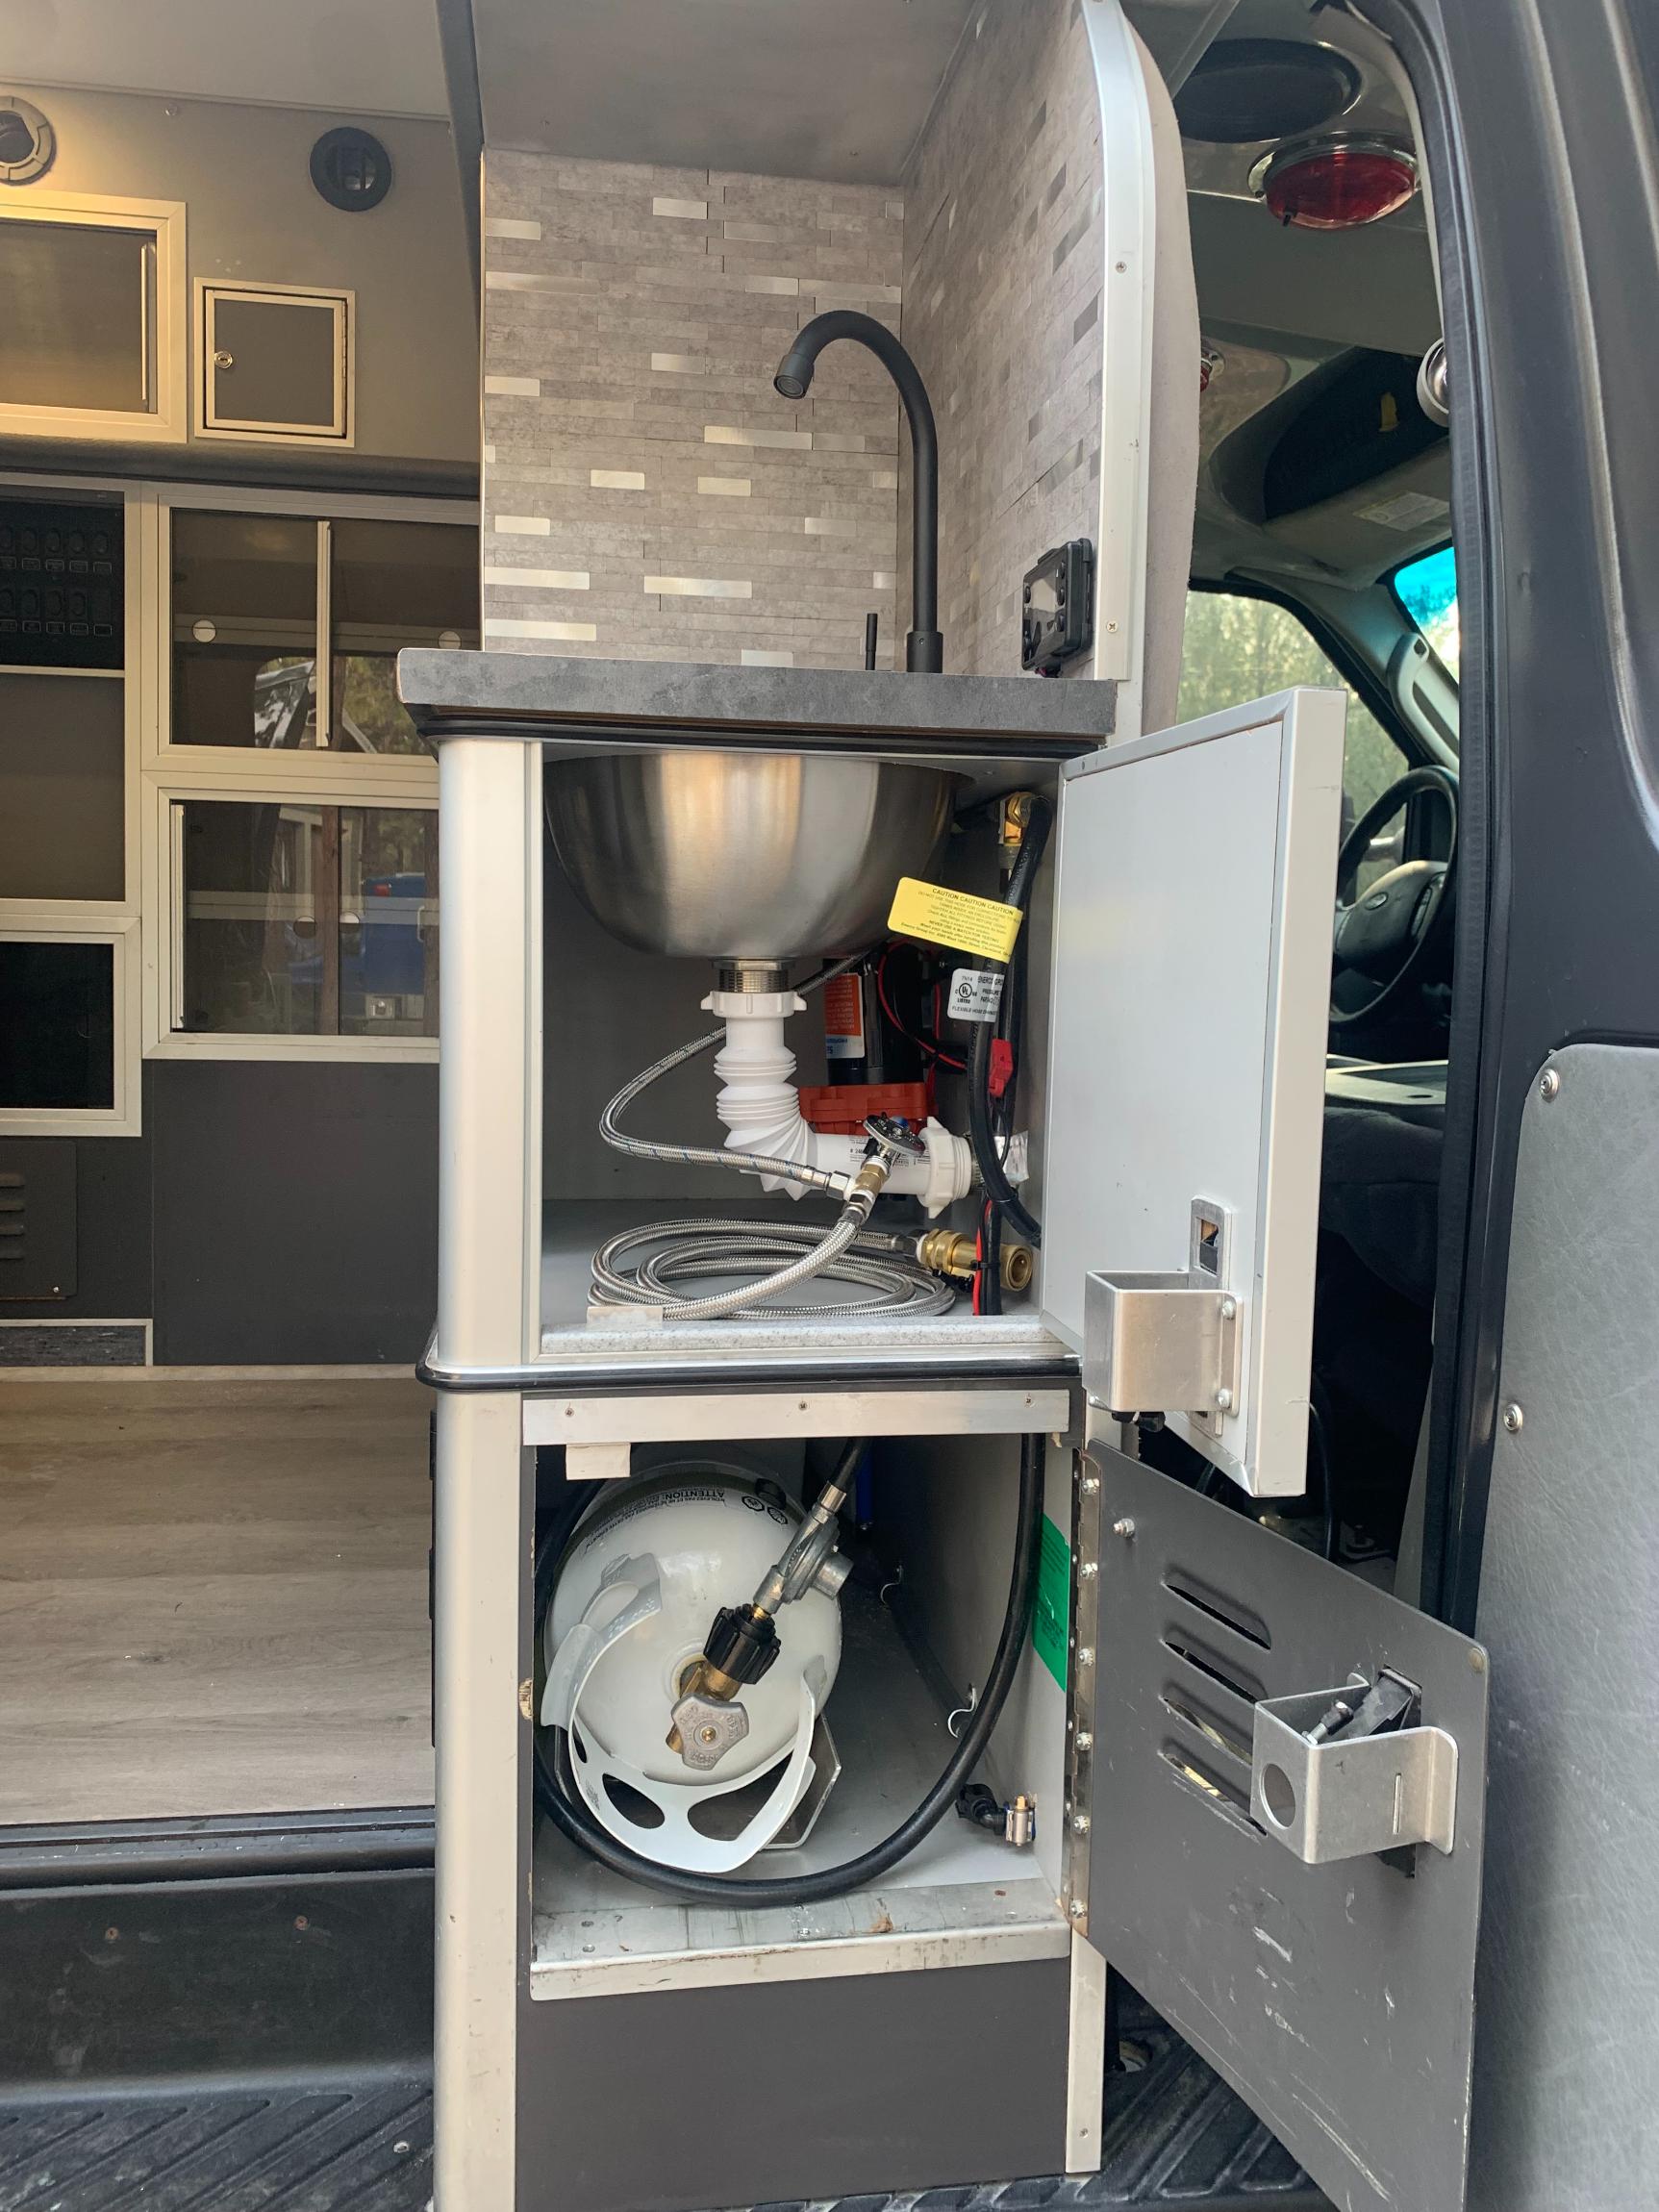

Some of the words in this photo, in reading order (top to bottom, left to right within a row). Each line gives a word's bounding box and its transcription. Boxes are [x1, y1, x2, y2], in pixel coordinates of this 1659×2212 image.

[932, 888, 959, 899] CAUTION
[959, 896, 986, 907] CAUTION
[987, 903, 1013, 915] CAUTION
[663, 1490, 724, 1500] ATTENTION:
